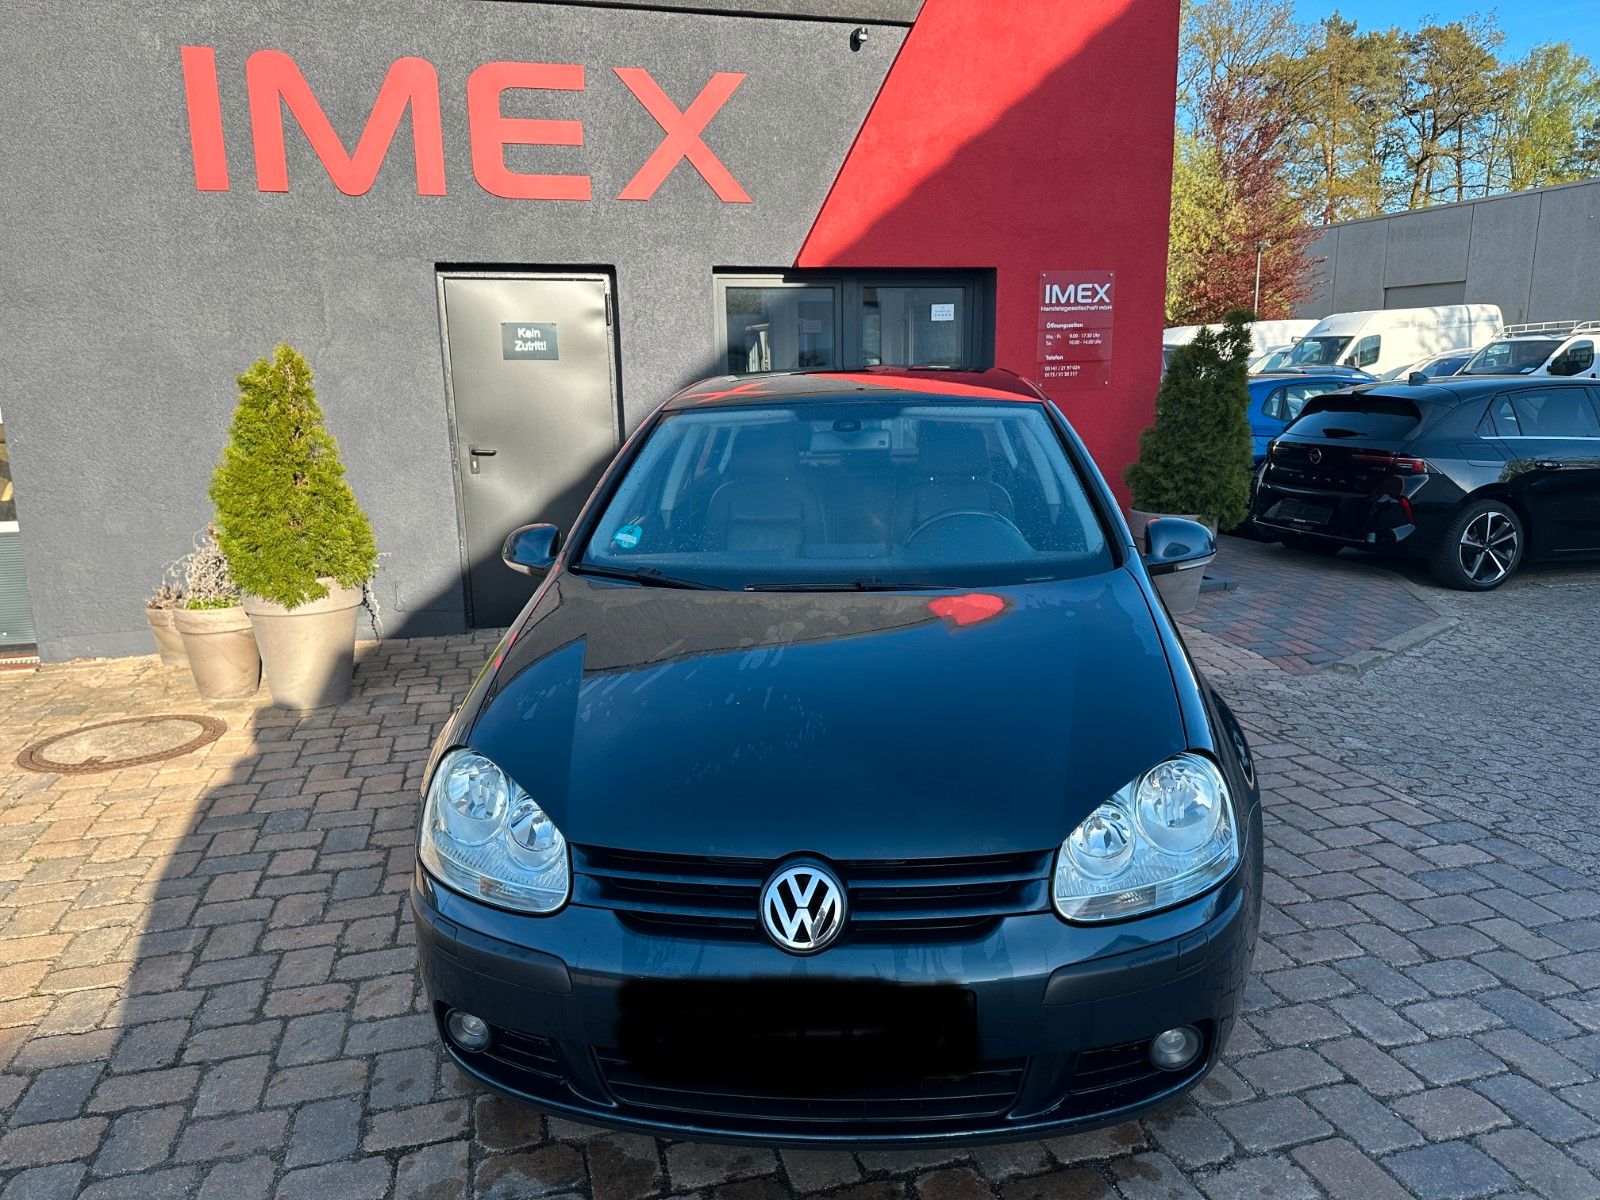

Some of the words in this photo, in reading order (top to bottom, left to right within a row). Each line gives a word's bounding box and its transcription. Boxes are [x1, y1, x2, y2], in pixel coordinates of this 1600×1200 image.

[181, 46, 752, 203] IMEX
[1045, 283, 1111, 304] IMEX
[517, 327, 541, 339] Kein
[764, 866, 841, 949] VW
